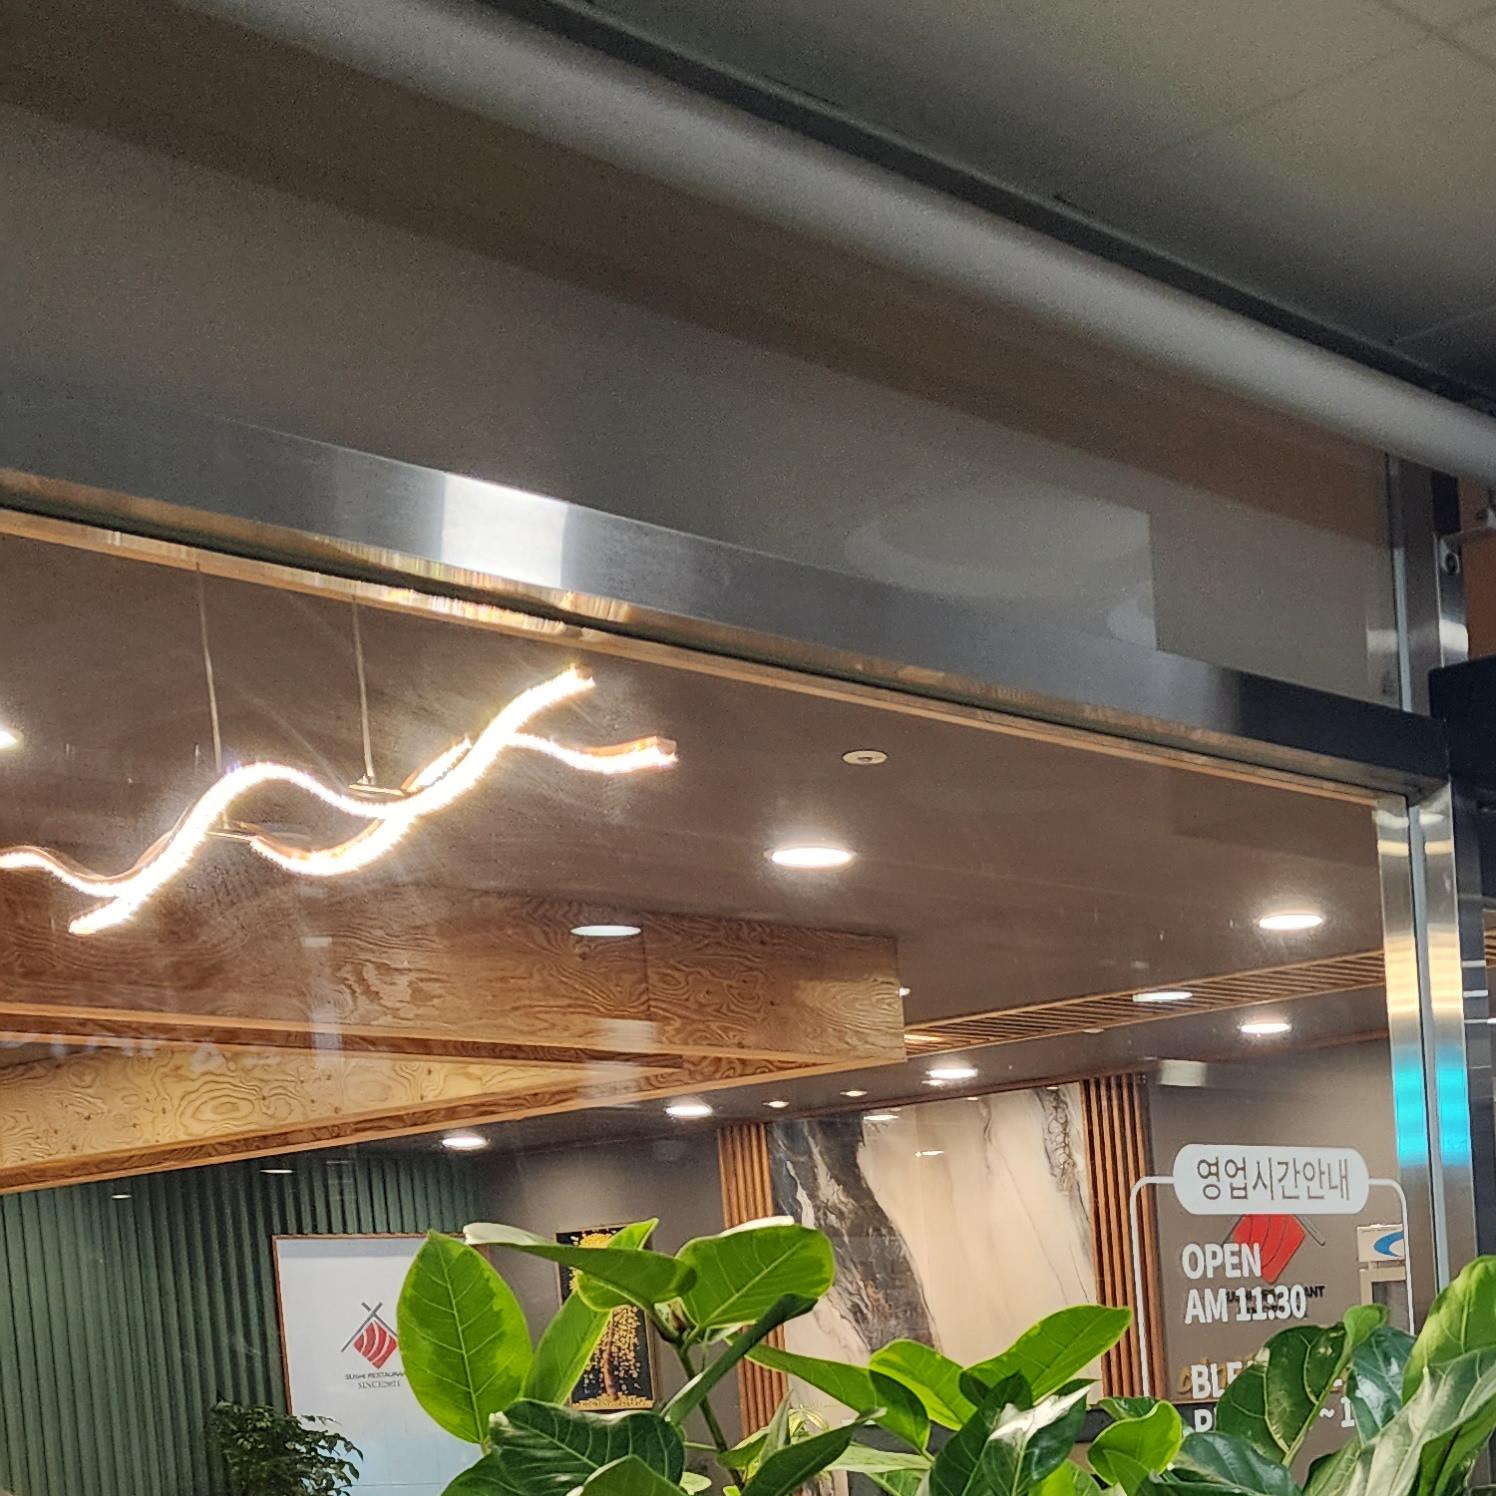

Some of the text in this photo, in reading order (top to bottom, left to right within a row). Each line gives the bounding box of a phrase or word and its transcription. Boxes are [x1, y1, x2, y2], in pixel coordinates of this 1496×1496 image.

[1197, 1156, 1350, 1201] 영업시간안내
[1182, 1242, 1262, 1280] OPEN
[1185, 1287, 1228, 1325] AM
[1236, 1284, 1307, 1322] 11:30
